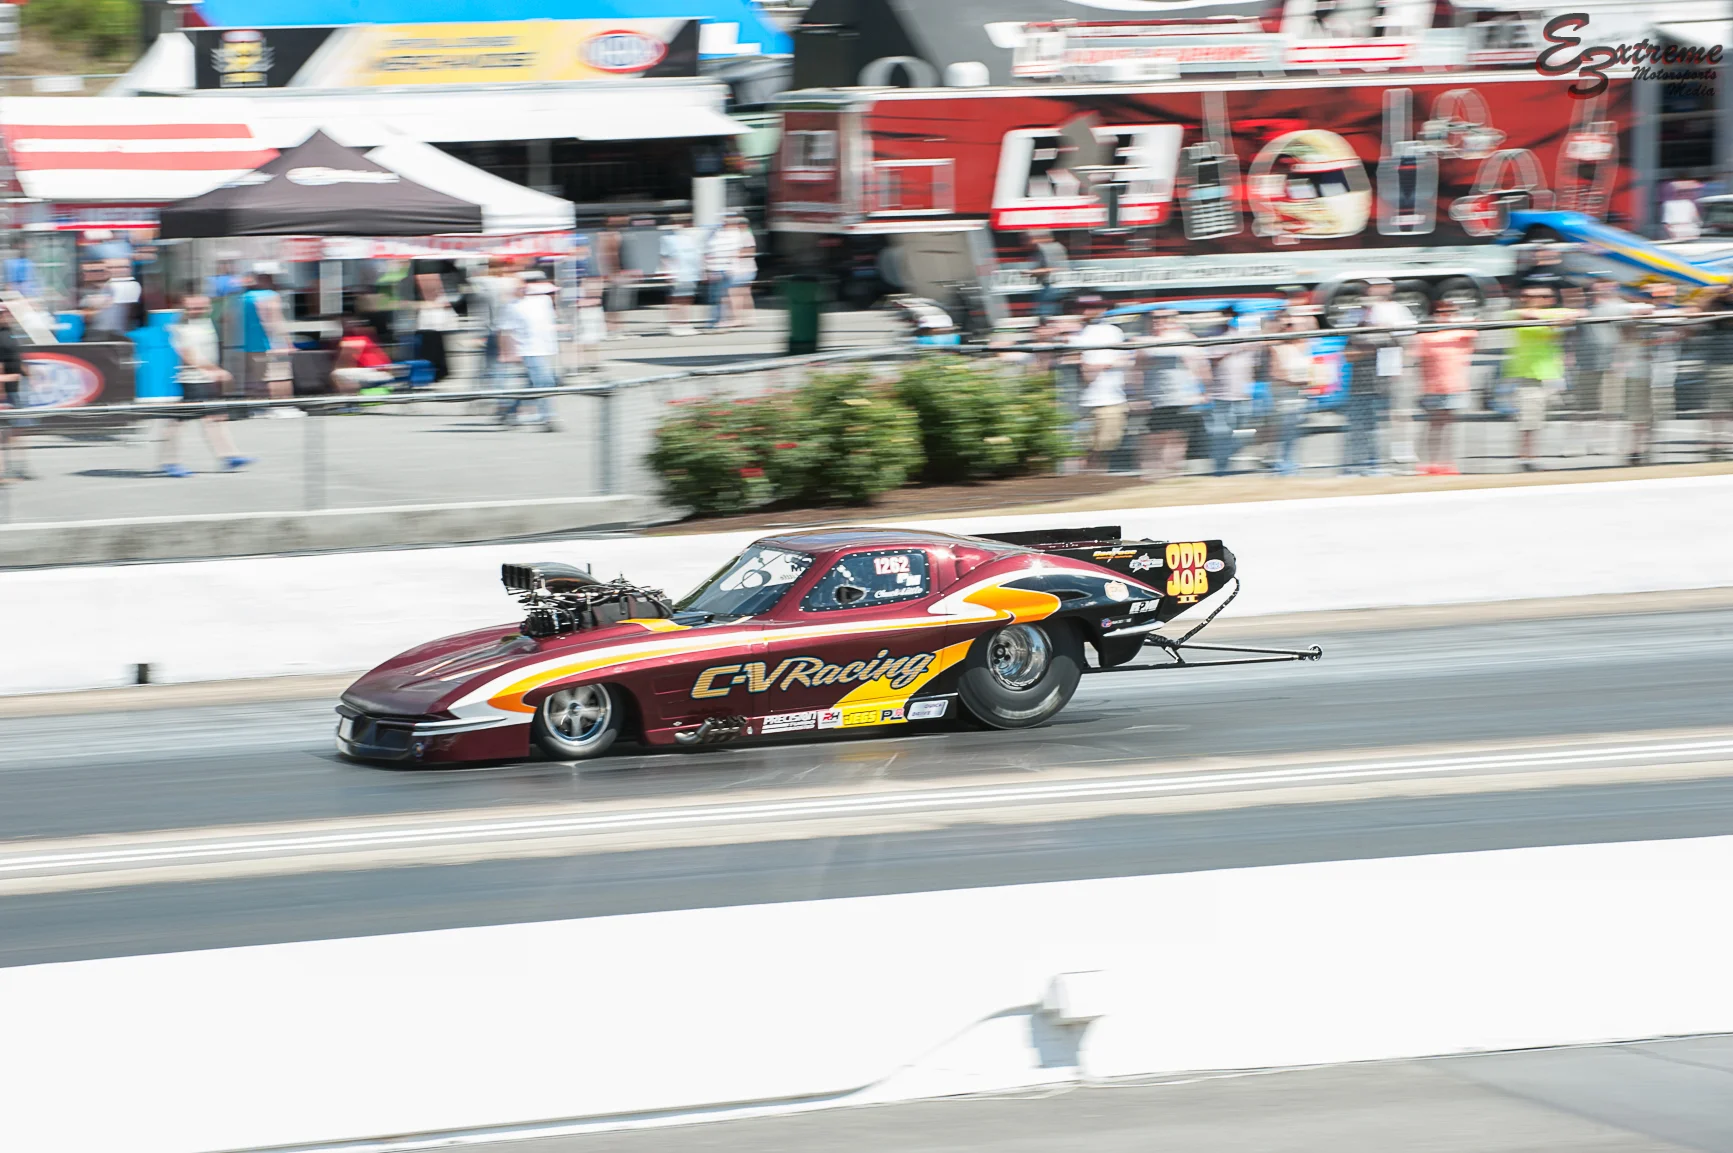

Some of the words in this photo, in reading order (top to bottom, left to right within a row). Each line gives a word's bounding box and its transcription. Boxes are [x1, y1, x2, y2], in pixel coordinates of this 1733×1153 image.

[1166, 541, 1207, 570] ODD
[873, 556, 910, 575] 1262
[1167, 569, 1208, 596] JOB
[762, 711, 818, 726] PRECISION
[844, 711, 877, 725] JEGS
